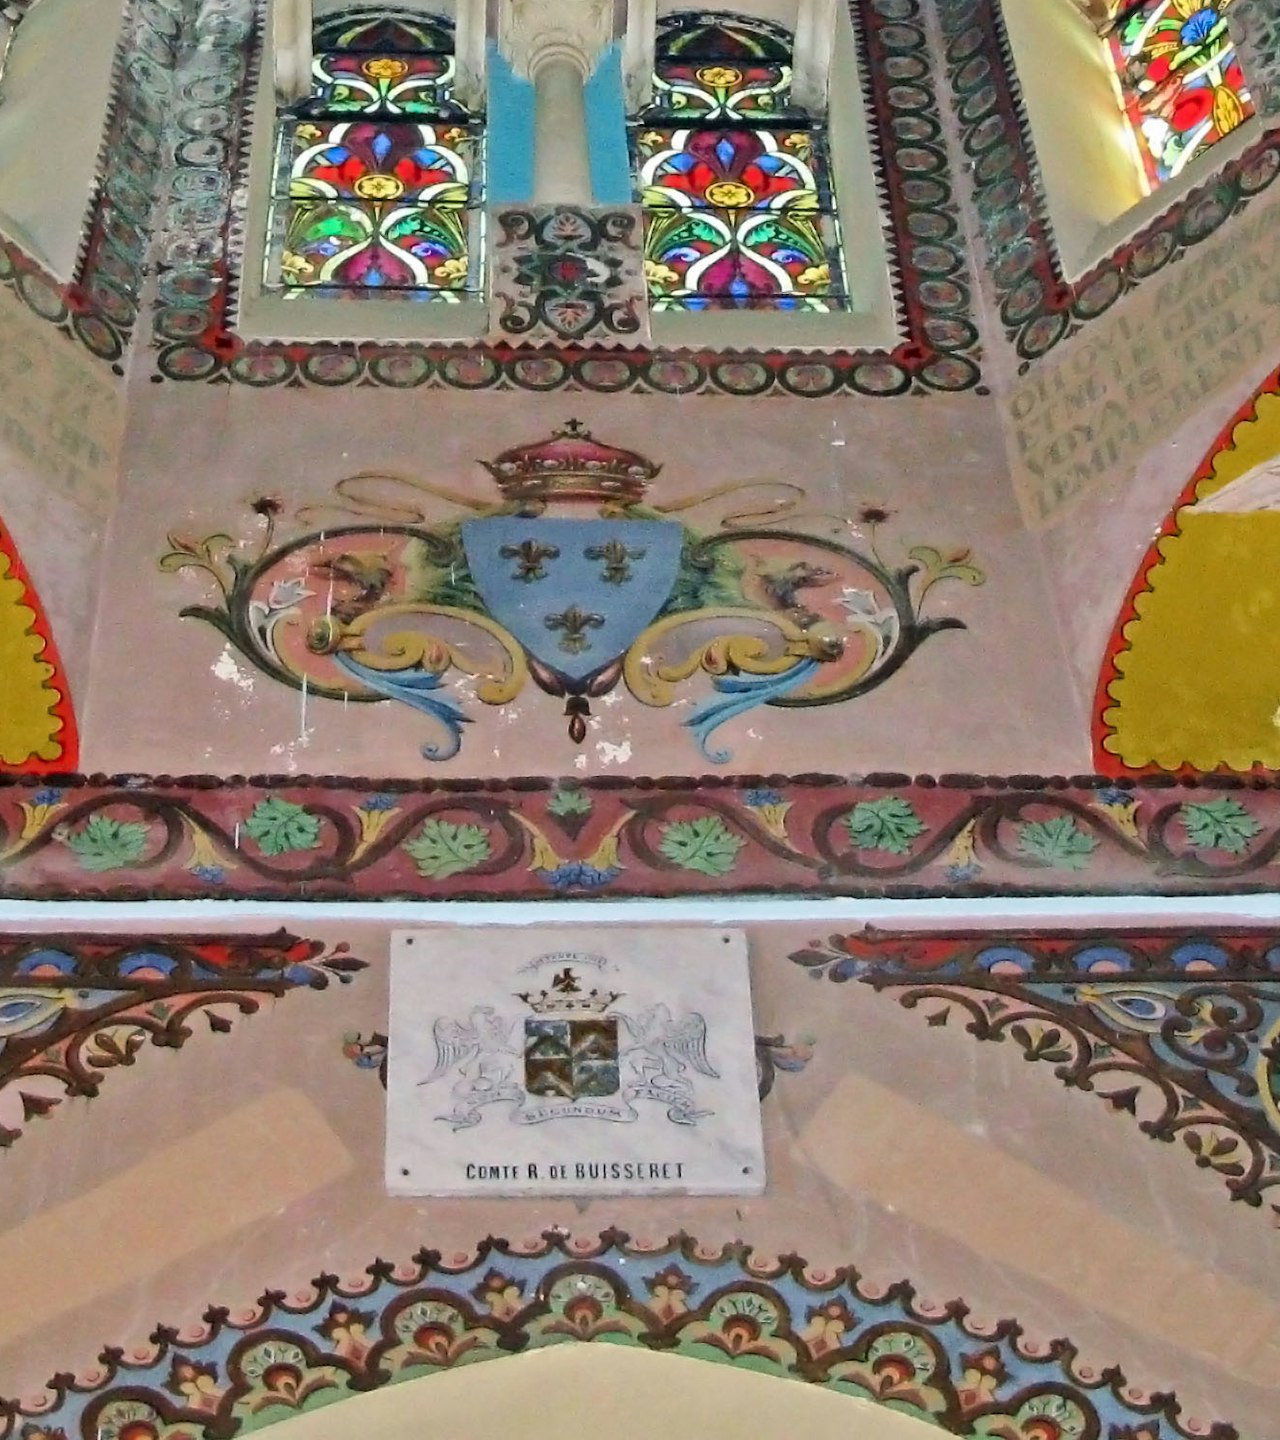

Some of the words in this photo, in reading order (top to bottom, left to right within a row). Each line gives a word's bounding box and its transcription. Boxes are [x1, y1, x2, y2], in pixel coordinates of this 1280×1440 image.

[466, 1163, 519, 1180] COMTE
[550, 1165, 567, 1179] DE
[576, 1162, 684, 1179] BUISSERET
